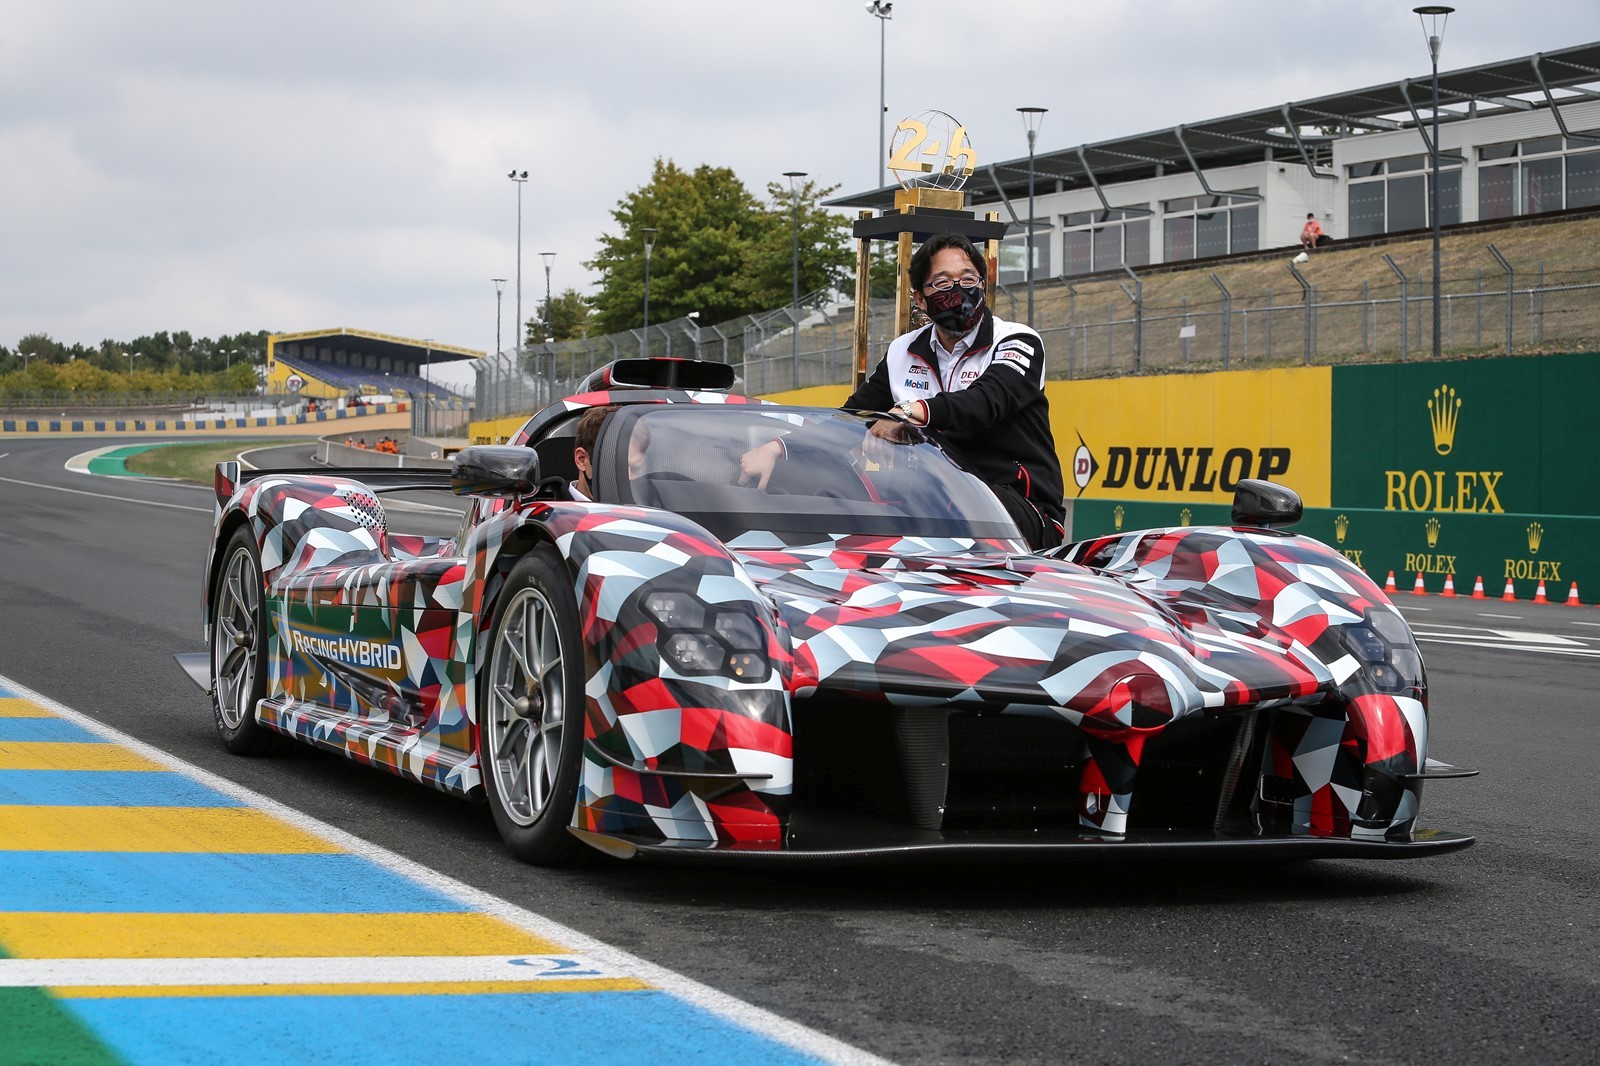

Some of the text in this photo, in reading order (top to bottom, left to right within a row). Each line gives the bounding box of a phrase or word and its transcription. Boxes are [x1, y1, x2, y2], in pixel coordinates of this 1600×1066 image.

[1003, 351, 1022, 361] ZENT
[904, 378, 924, 390] Mobil
[1076, 458, 1089, 474] D
[1102, 447, 1291, 493] DUNLOP
[1384, 470, 1505, 513] ROLEX
[1405, 553, 1456, 574] ROLEX
[1504, 559, 1561, 581] ROLEX
